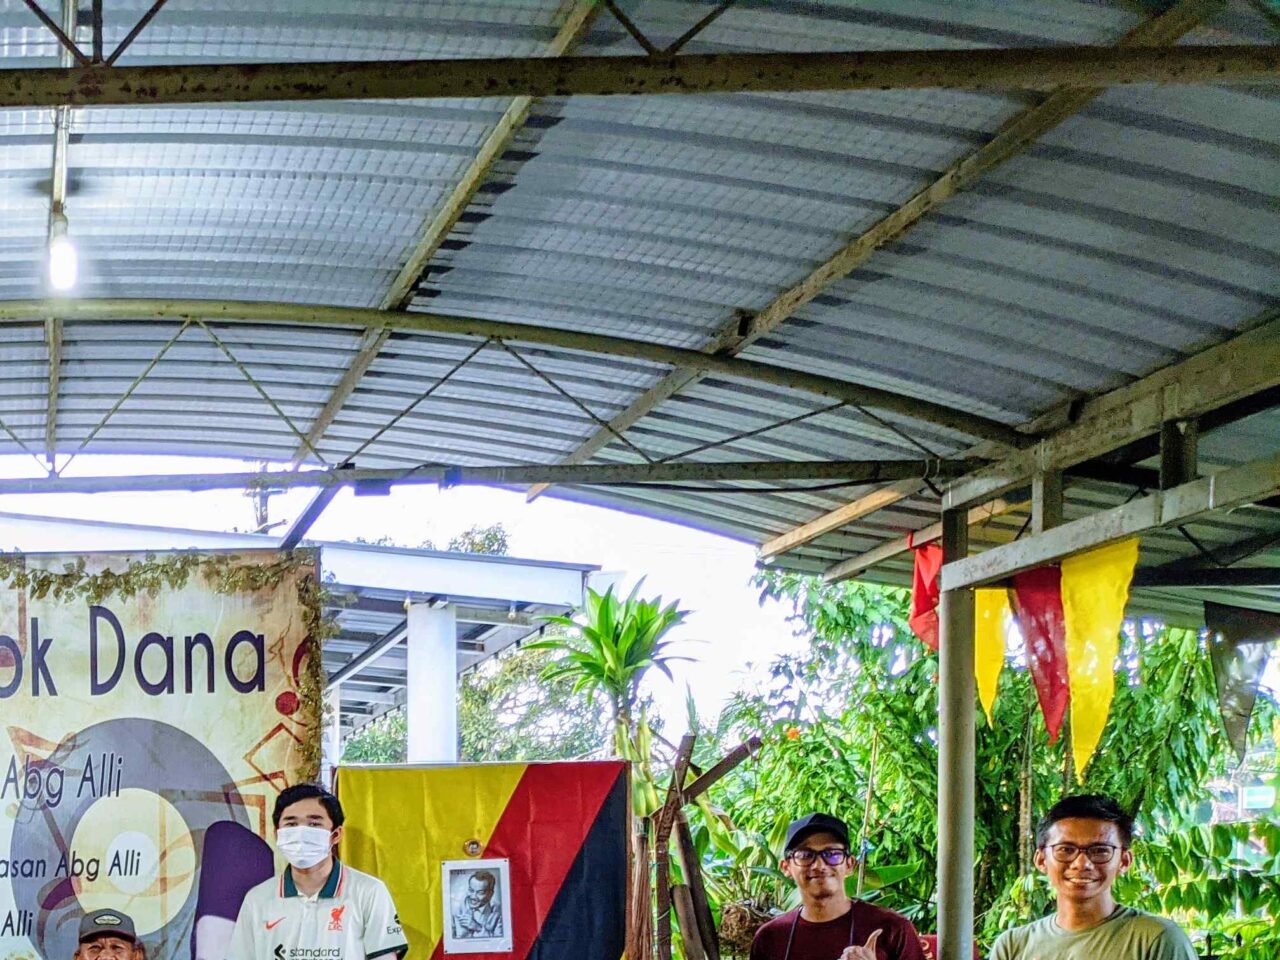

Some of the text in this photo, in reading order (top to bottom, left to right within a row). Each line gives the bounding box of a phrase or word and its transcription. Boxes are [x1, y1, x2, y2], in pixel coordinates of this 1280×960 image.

[89, 604, 266, 697] Dana
[1, 753, 65, 809] Abg
[76, 752, 123, 799] Alli
[54, 850, 100, 882] Abg
[108, 849, 141, 876] Alli
[0, 909, 33, 937] Alli
[289, 947, 341, 958] standard
